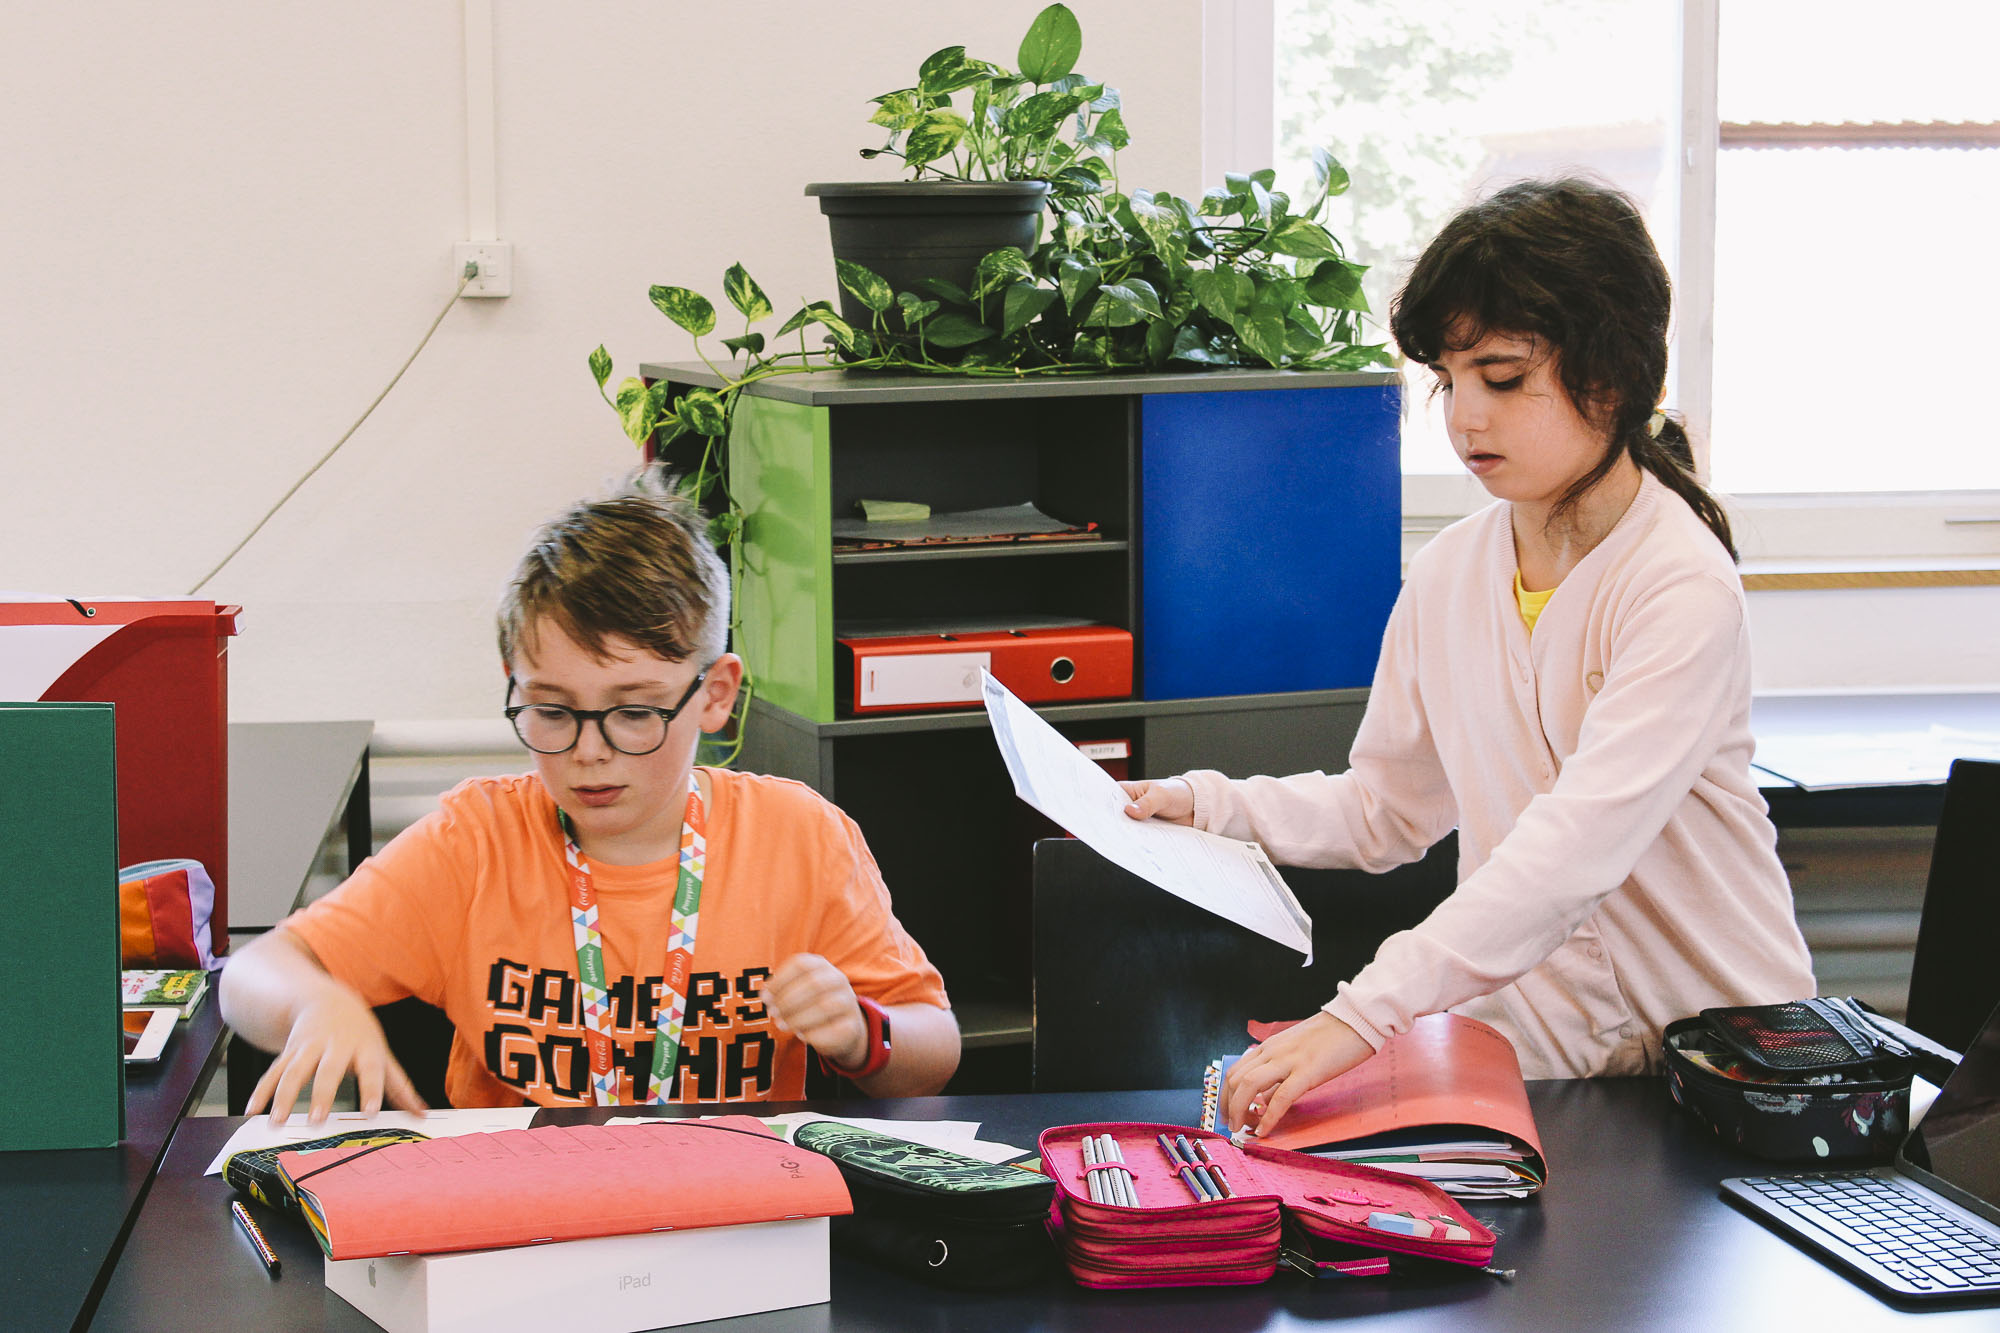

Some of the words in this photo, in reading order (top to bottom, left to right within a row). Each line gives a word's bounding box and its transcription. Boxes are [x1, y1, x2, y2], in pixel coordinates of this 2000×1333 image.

[487, 957, 773, 1034] GAMERS
[484, 1022, 776, 1103] GONNA
[618, 1272, 651, 1291] iPad
